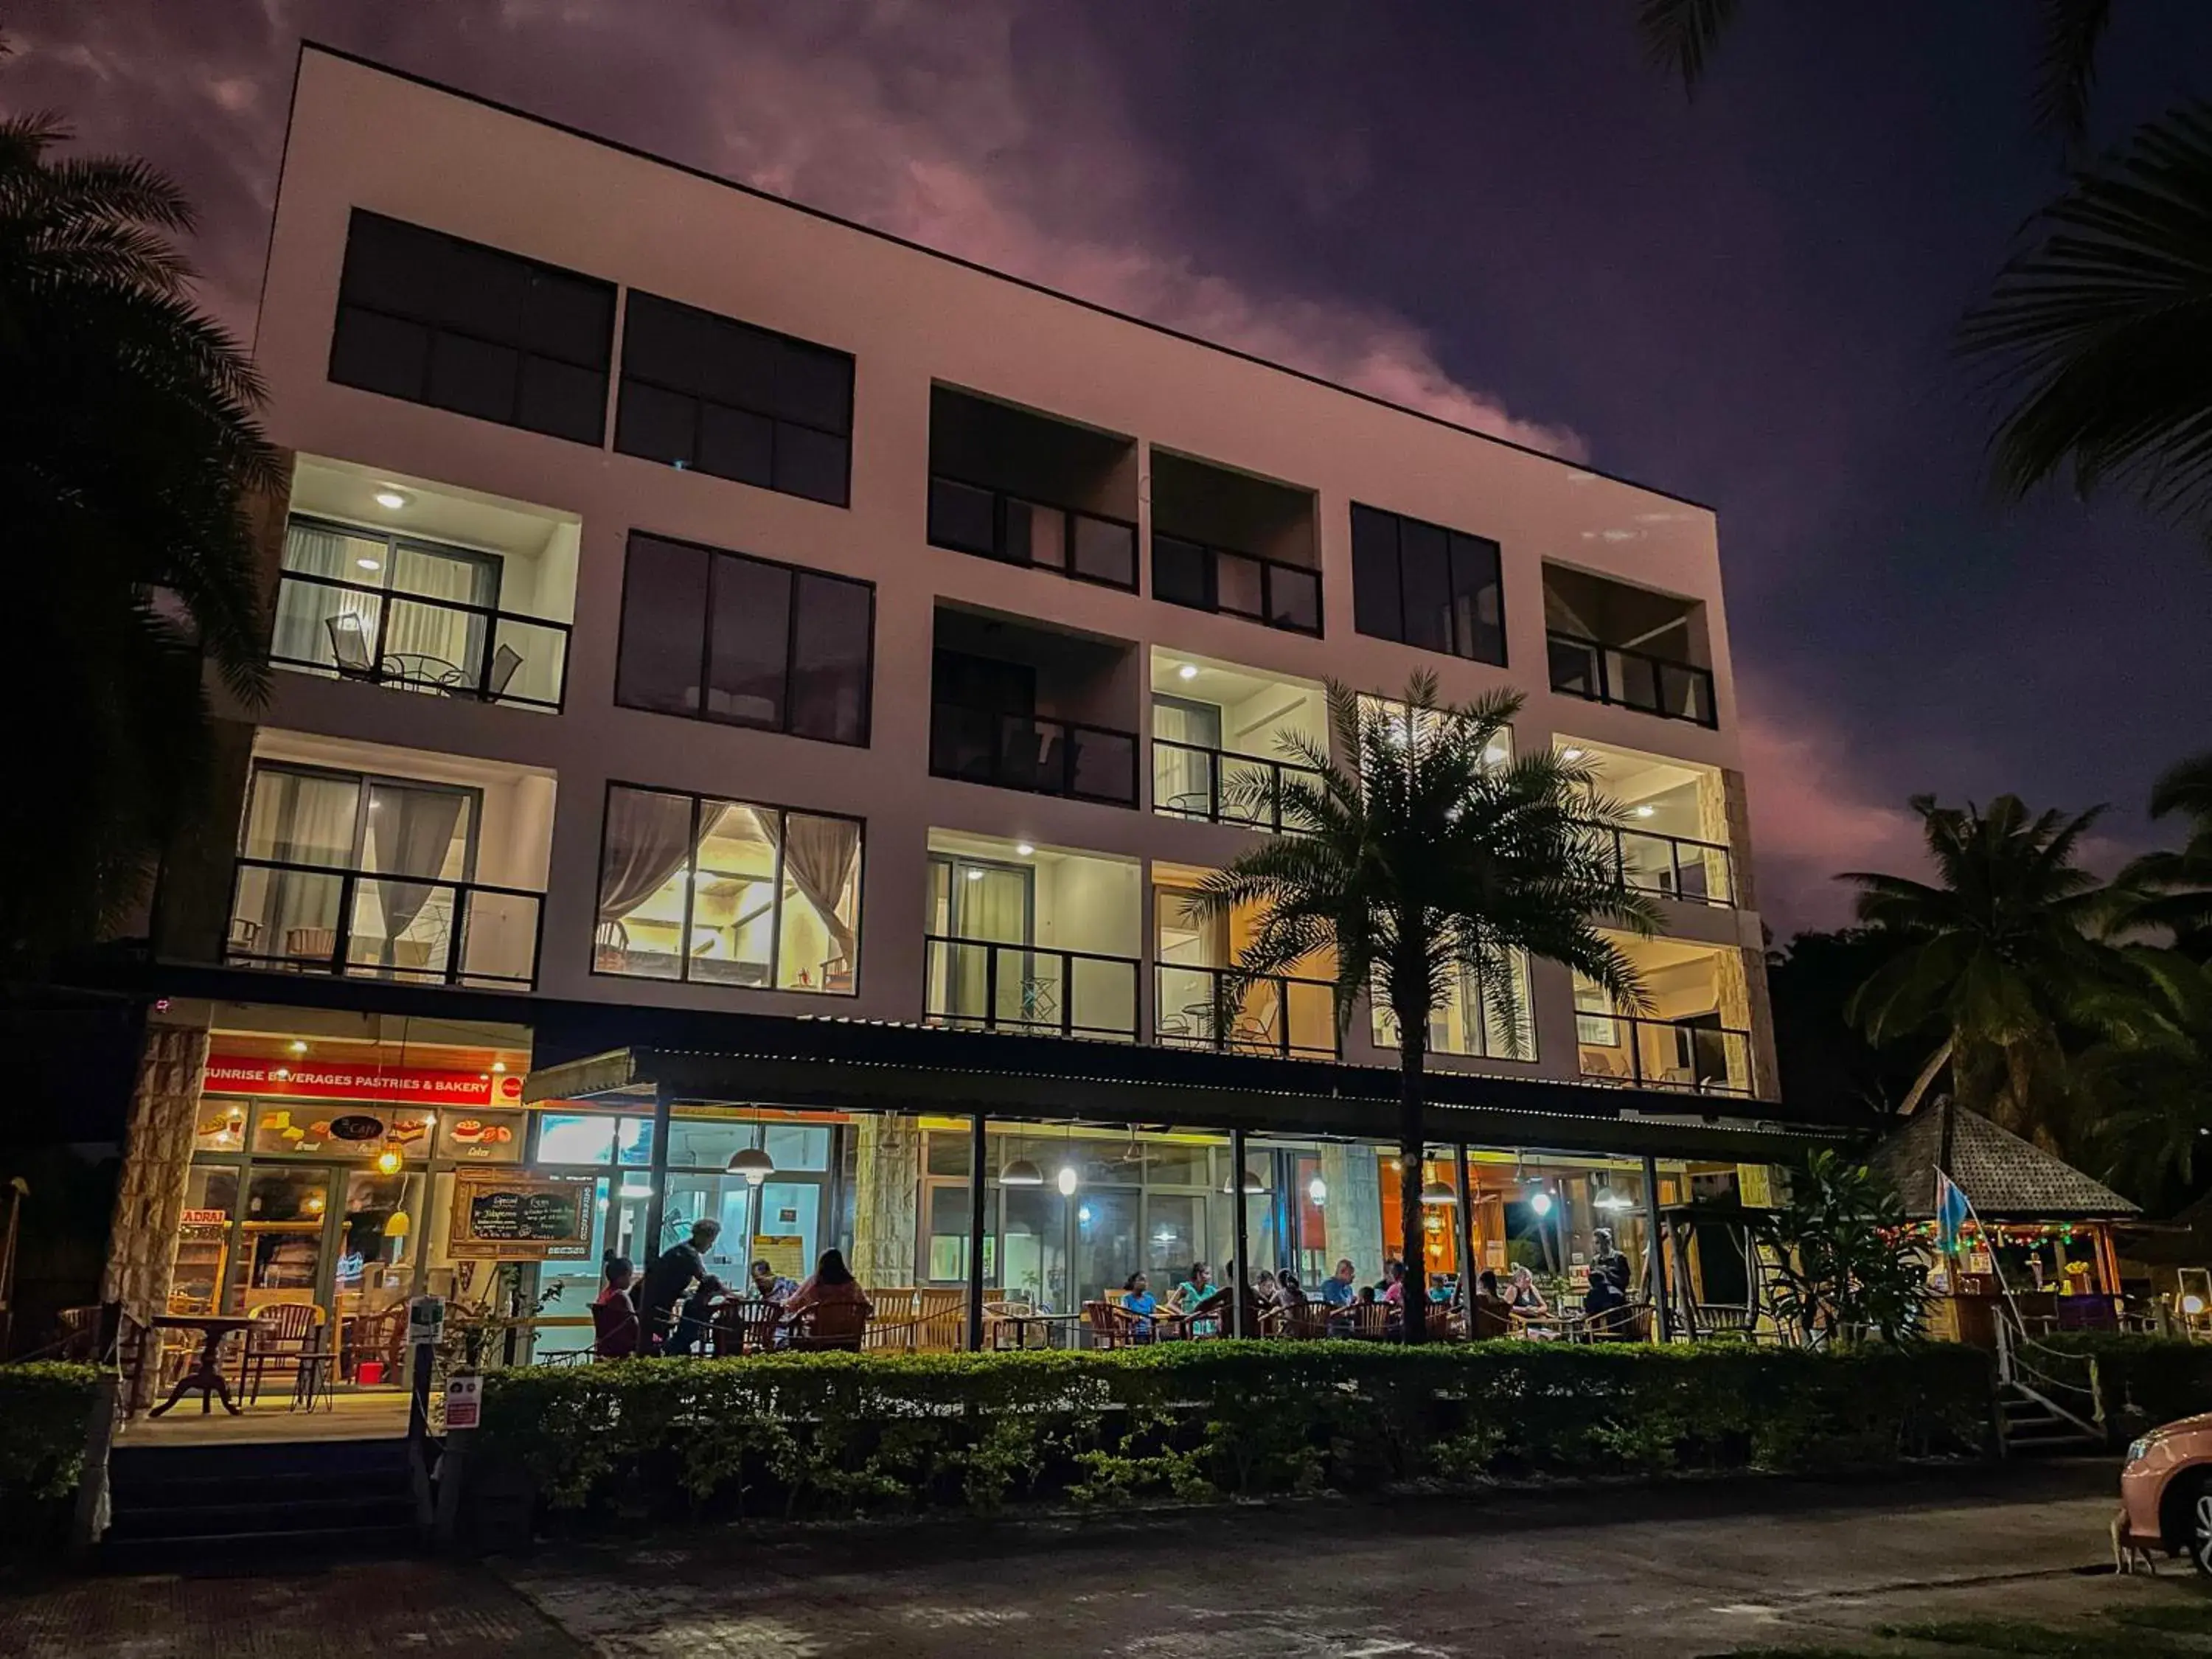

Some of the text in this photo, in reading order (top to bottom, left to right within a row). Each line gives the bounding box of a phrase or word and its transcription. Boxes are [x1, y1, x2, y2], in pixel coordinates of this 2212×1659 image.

[205, 1068, 265, 1081] SUNRISE
[355, 1075, 420, 1090] PASTRIES
[422, 1082, 432, 1091] &
[435, 1082, 489, 1093] BAKERY
[184, 1211, 223, 1222] ADRAI
